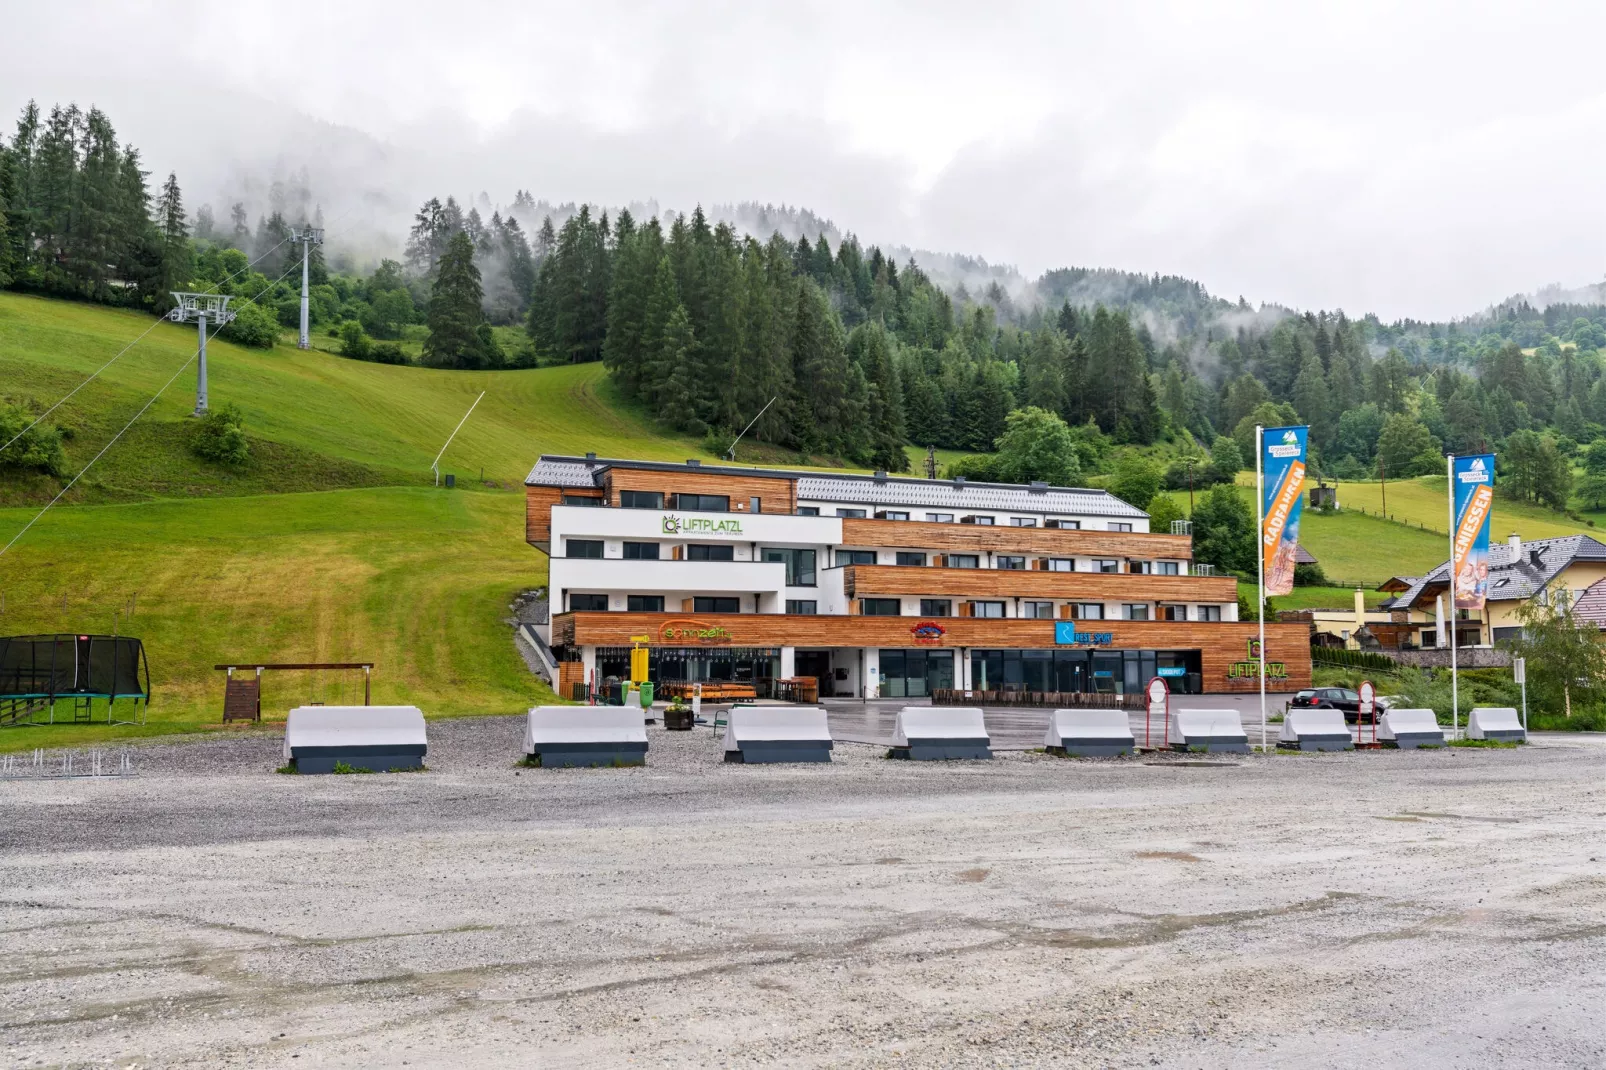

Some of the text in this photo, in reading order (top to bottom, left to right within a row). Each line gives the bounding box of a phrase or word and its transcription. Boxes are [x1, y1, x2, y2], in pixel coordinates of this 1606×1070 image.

[682, 518, 743, 532] LIFTPLATZL
[1263, 467, 1305, 546] RADFAHREN
[1455, 489, 1492, 563] GENIESSEN
[1228, 663, 1289, 677] LIFTPLATZL
